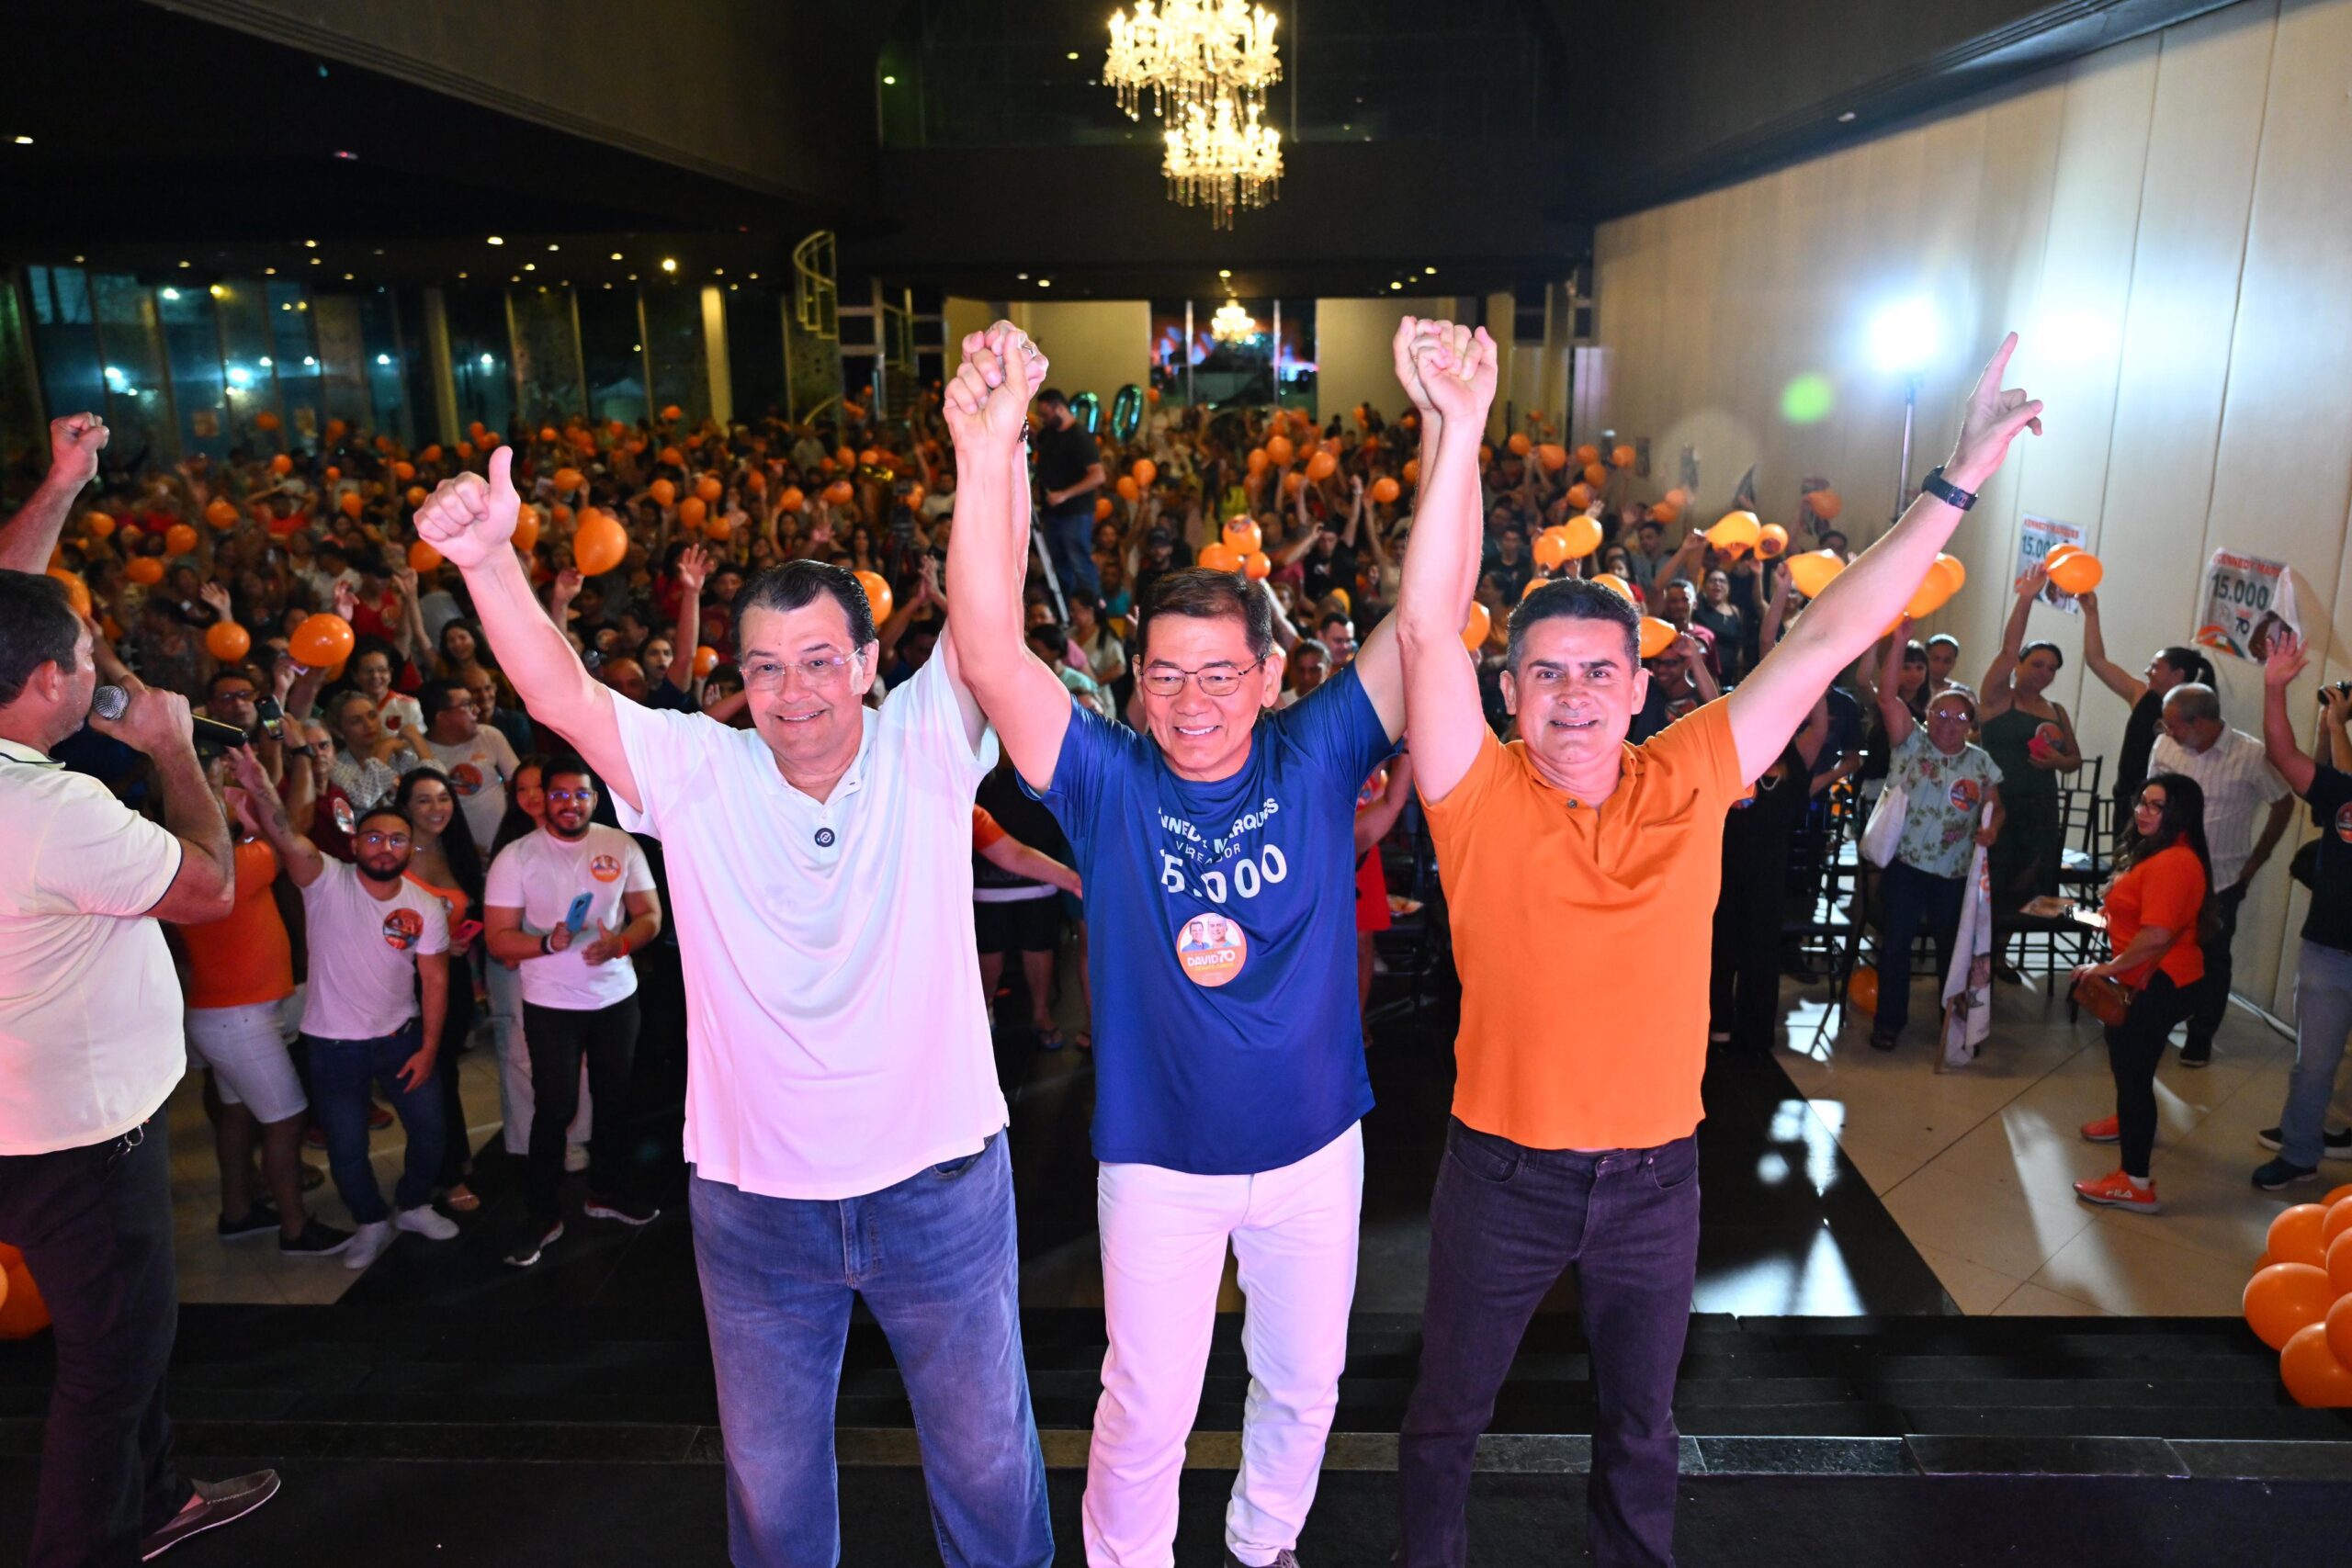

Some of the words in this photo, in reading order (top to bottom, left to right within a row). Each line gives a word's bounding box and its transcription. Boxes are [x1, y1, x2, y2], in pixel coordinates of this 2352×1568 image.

[2022, 536, 2058, 558] 15.00
[2212, 574, 2268, 611] 15.000
[2235, 616, 2250, 635] 70
[1159, 844, 1287, 903] 5.000
[2106, 1189, 2132, 1198] FILA
